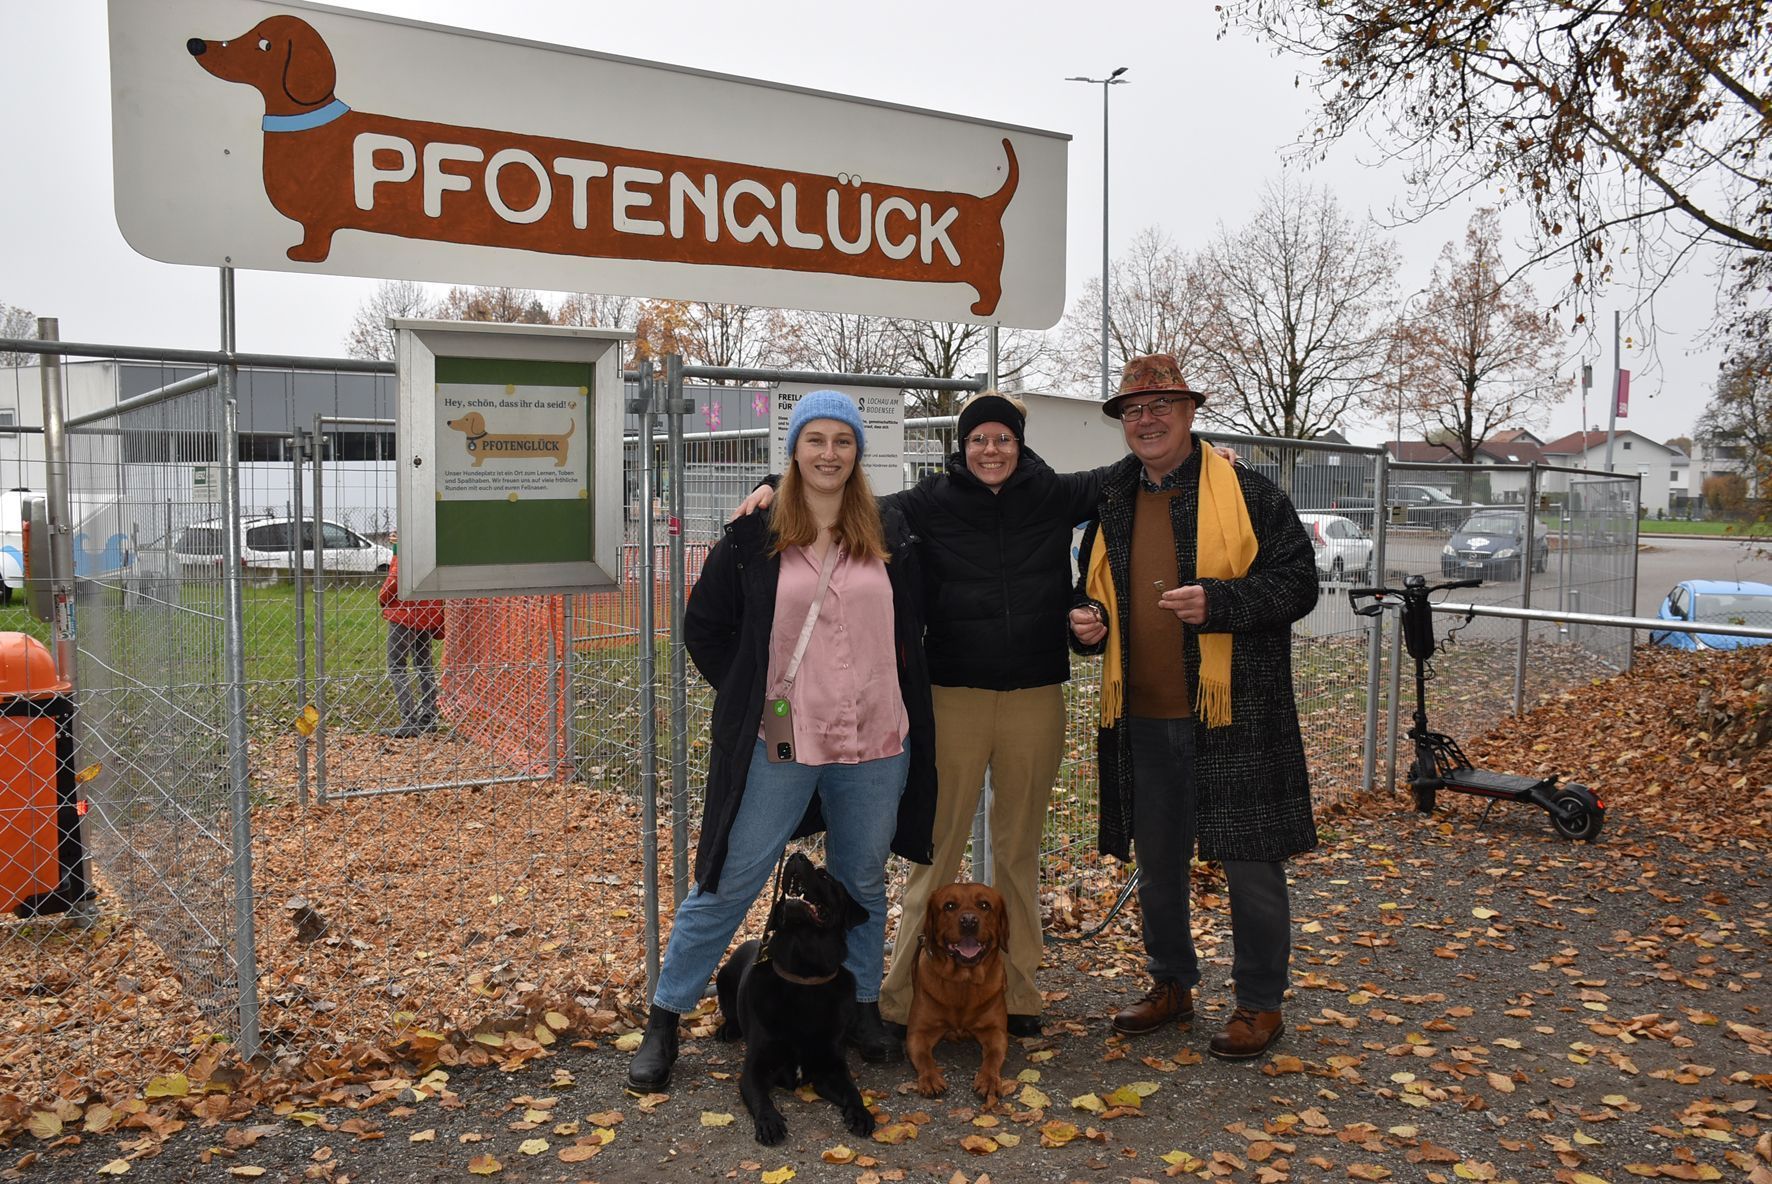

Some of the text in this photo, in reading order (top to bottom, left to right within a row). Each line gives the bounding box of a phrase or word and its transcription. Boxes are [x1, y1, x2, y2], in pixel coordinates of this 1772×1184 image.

[352, 131, 961, 268] PFOTENGLÜCK
[444, 398, 567, 409] Hey, schön, dass ihr da seid!
[778, 401, 793, 410] FÜR
[867, 397, 889, 405] LOCHAU
[866, 406, 895, 414] BODENSEE
[482, 438, 559, 452] PFOTENGLÜCK
